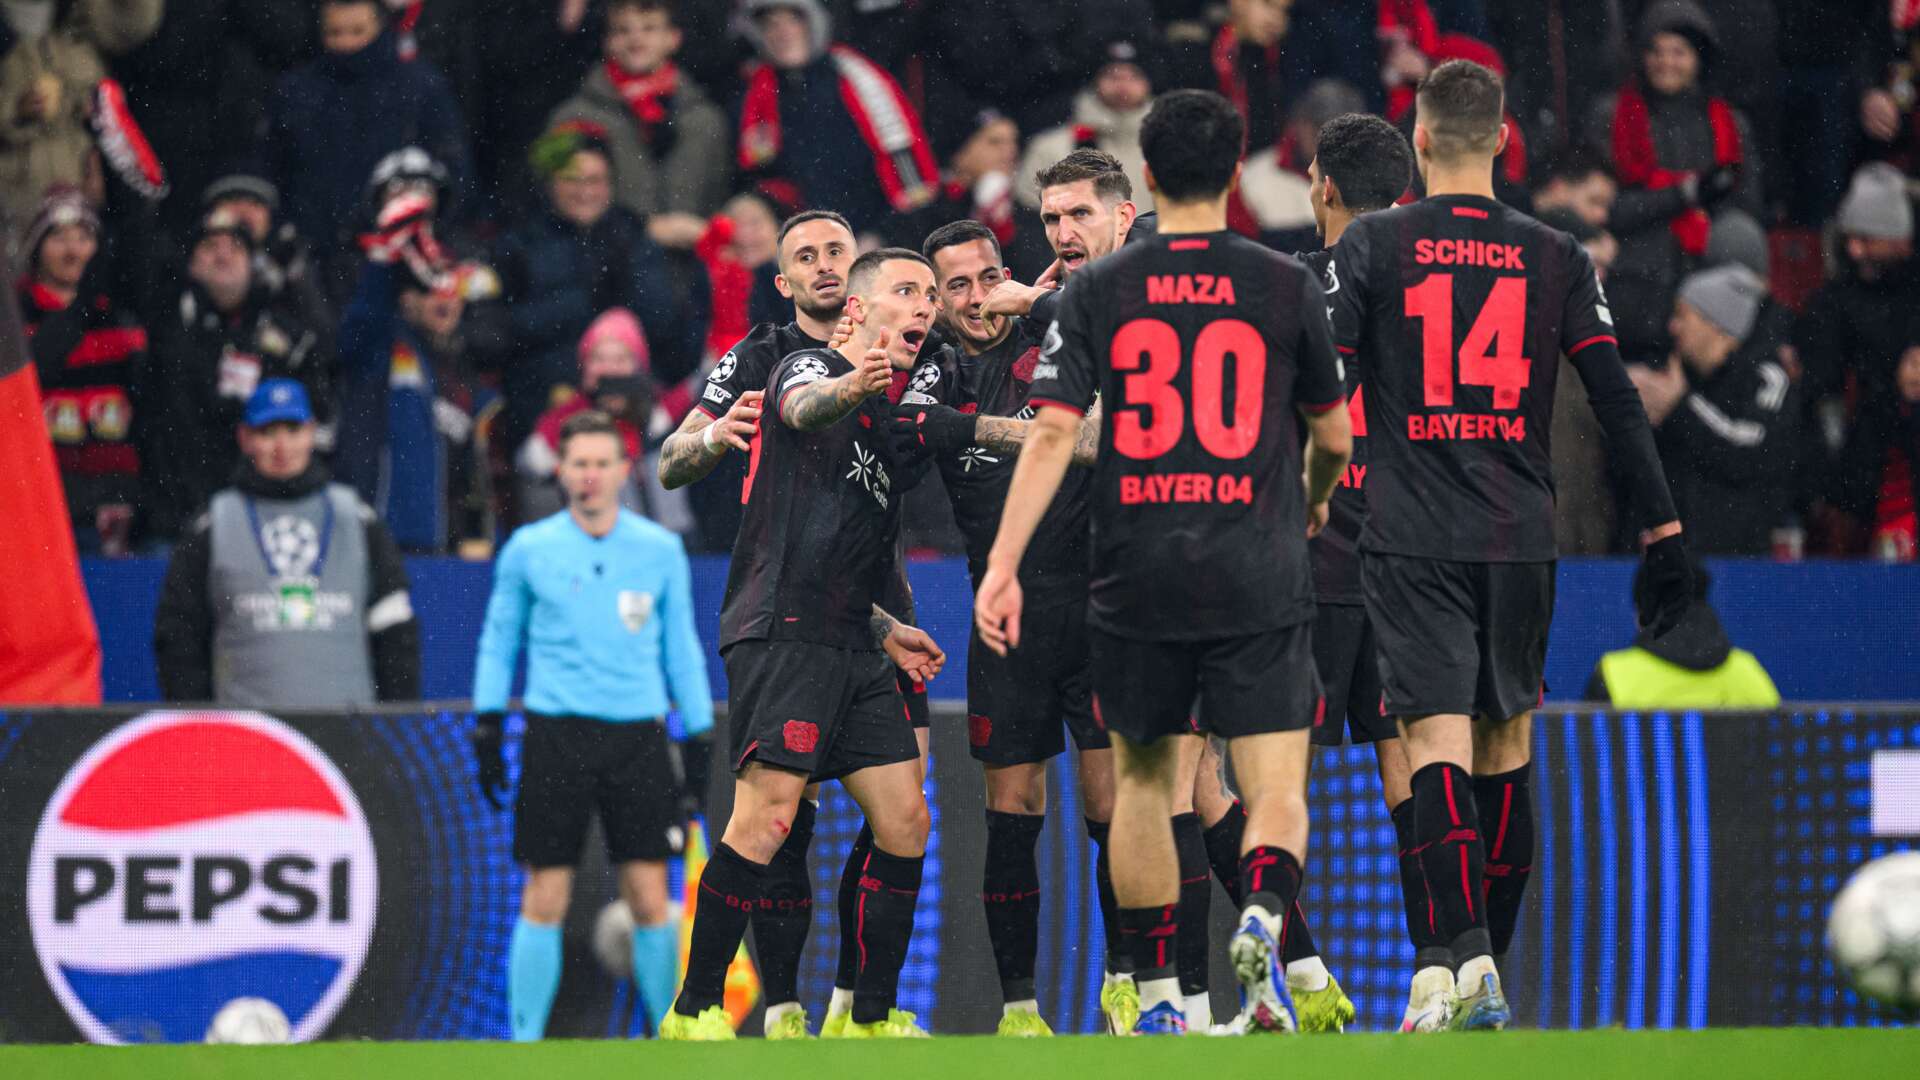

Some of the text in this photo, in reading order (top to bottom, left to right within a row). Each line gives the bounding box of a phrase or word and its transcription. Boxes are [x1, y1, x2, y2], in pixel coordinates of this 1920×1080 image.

[1415, 239, 1525, 270] SCHICK
[1146, 274, 1236, 305] MAZA
[1404, 273, 1532, 410] 14
[1110, 318, 1267, 460] 30
[1408, 413, 1526, 442] BAYER 04
[1120, 473, 1253, 505] BAYER 04
[54, 855, 350, 925] PEPSI
